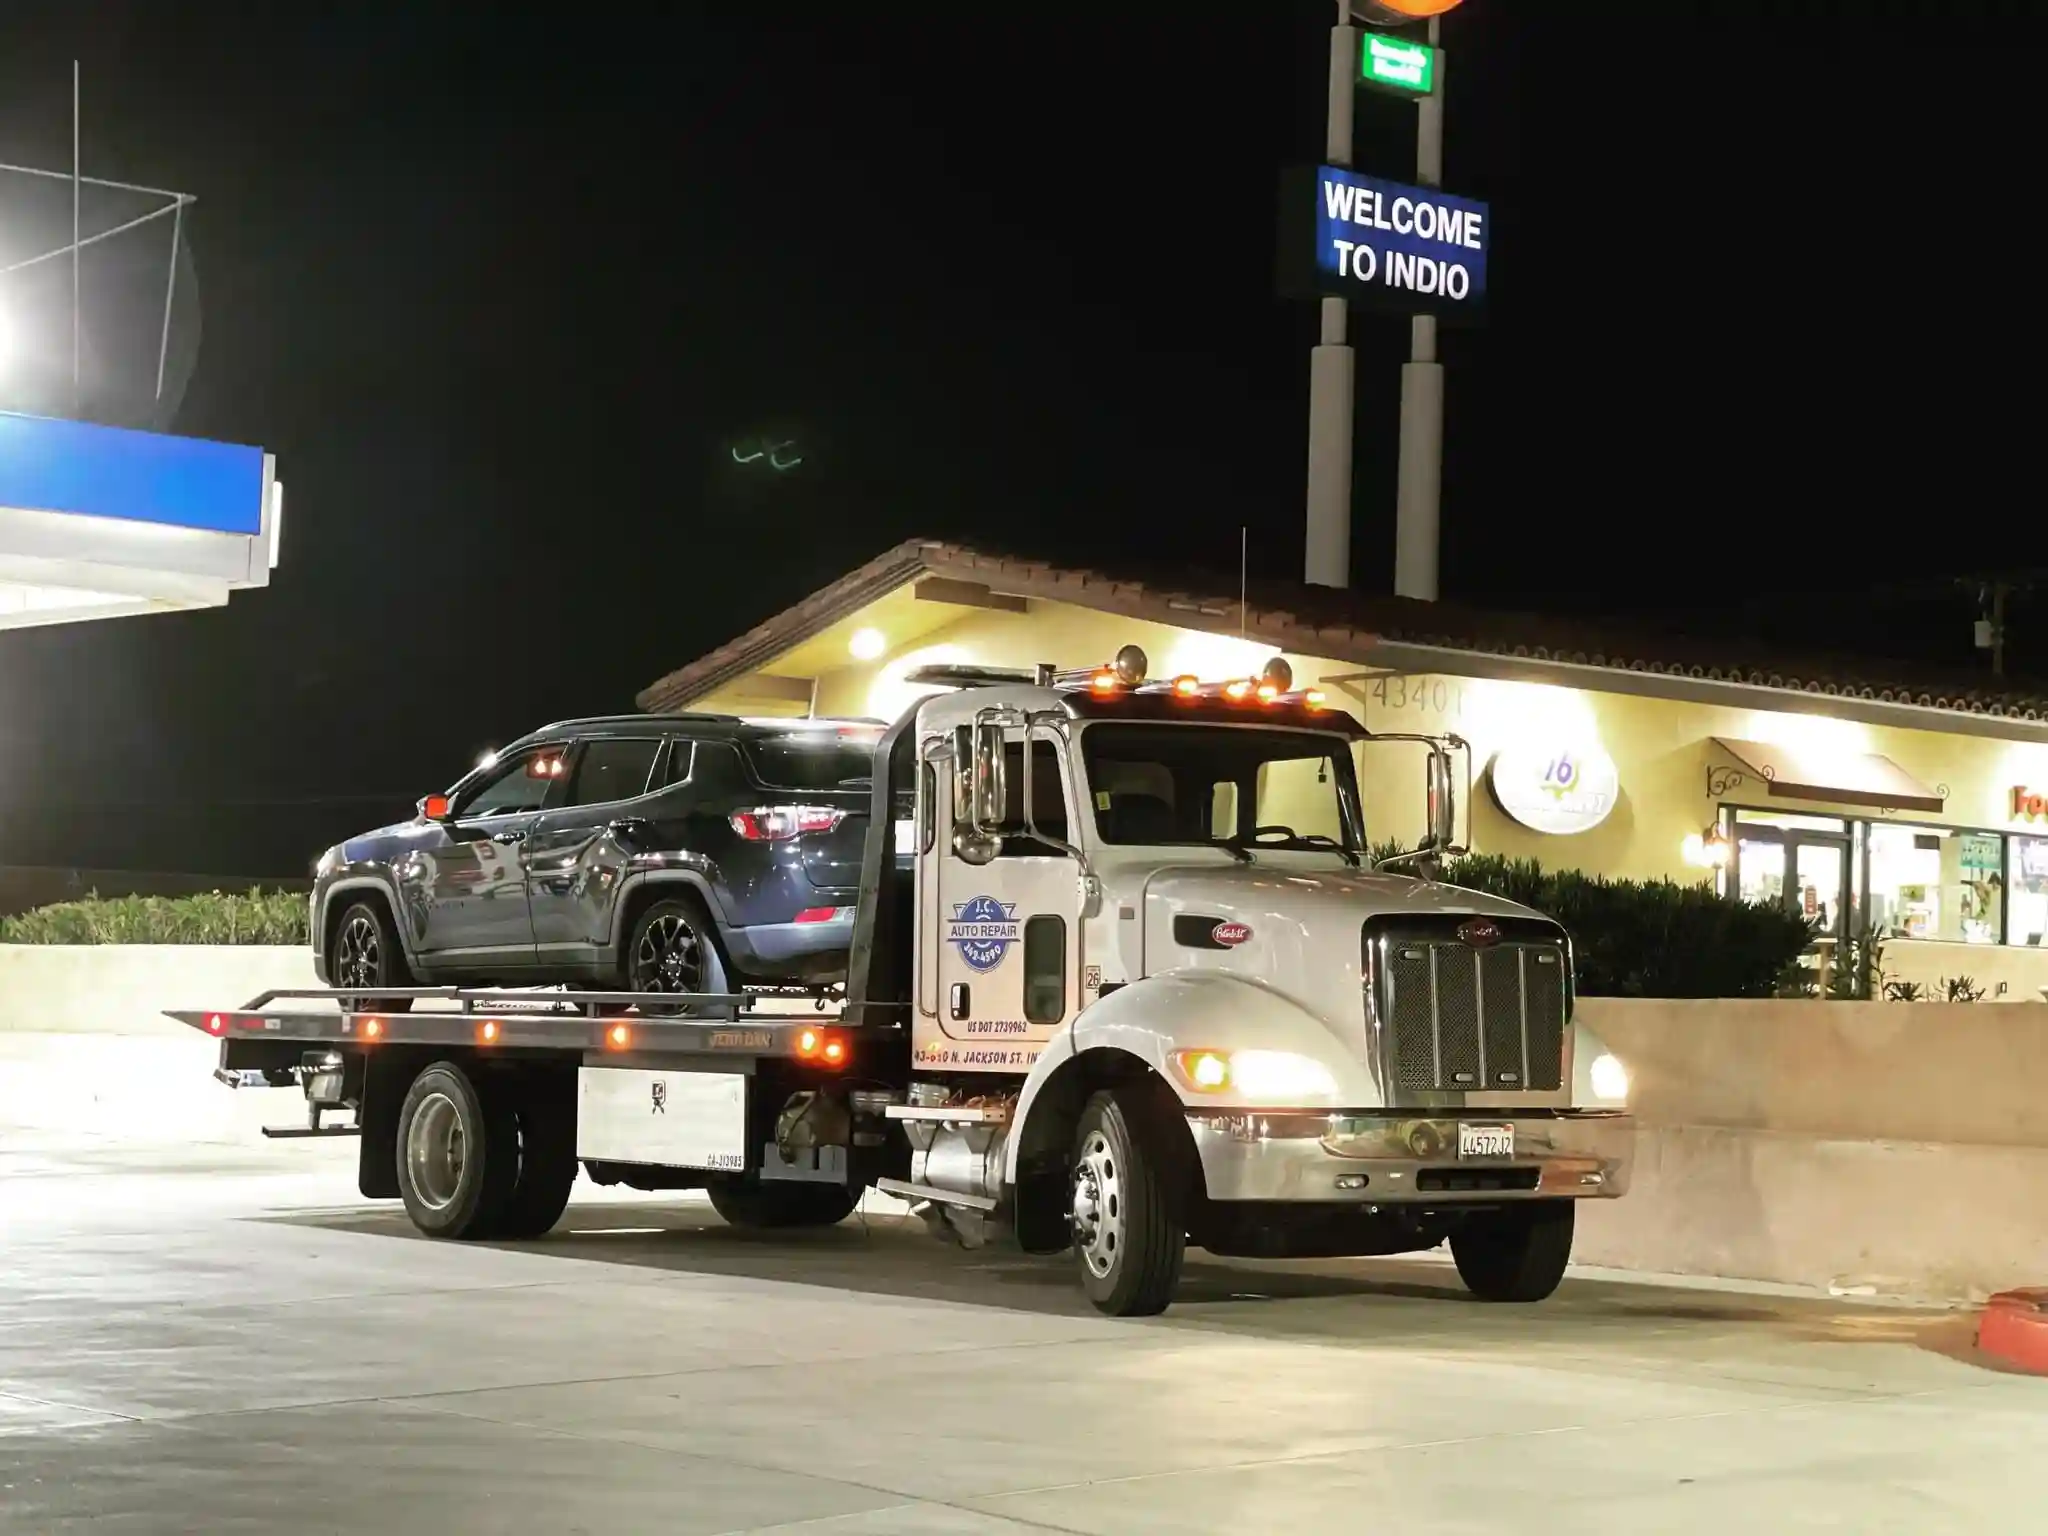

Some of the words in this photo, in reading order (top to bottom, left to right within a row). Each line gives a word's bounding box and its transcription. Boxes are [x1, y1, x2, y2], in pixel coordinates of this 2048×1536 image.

[1324, 180, 1482, 249] WELCOME
[1333, 239, 1376, 281] TO
[1385, 250, 1469, 300] INDIO
[1372, 676, 1462, 716] 43401
[951, 925, 978, 937] AUTO
[980, 924, 1017, 937] REPAIR
[1087, 972, 1099, 986] 26
[967, 1021, 976, 1032] US
[978, 1021, 993, 1033] DOT
[994, 1021, 1027, 1034] 2739962
[951, 1051, 961, 1064] N.
[963, 1051, 1007, 1064] JACKSON
[1009, 1052, 1023, 1064] ST.
[1463, 1135, 1511, 1155] 44572J2
